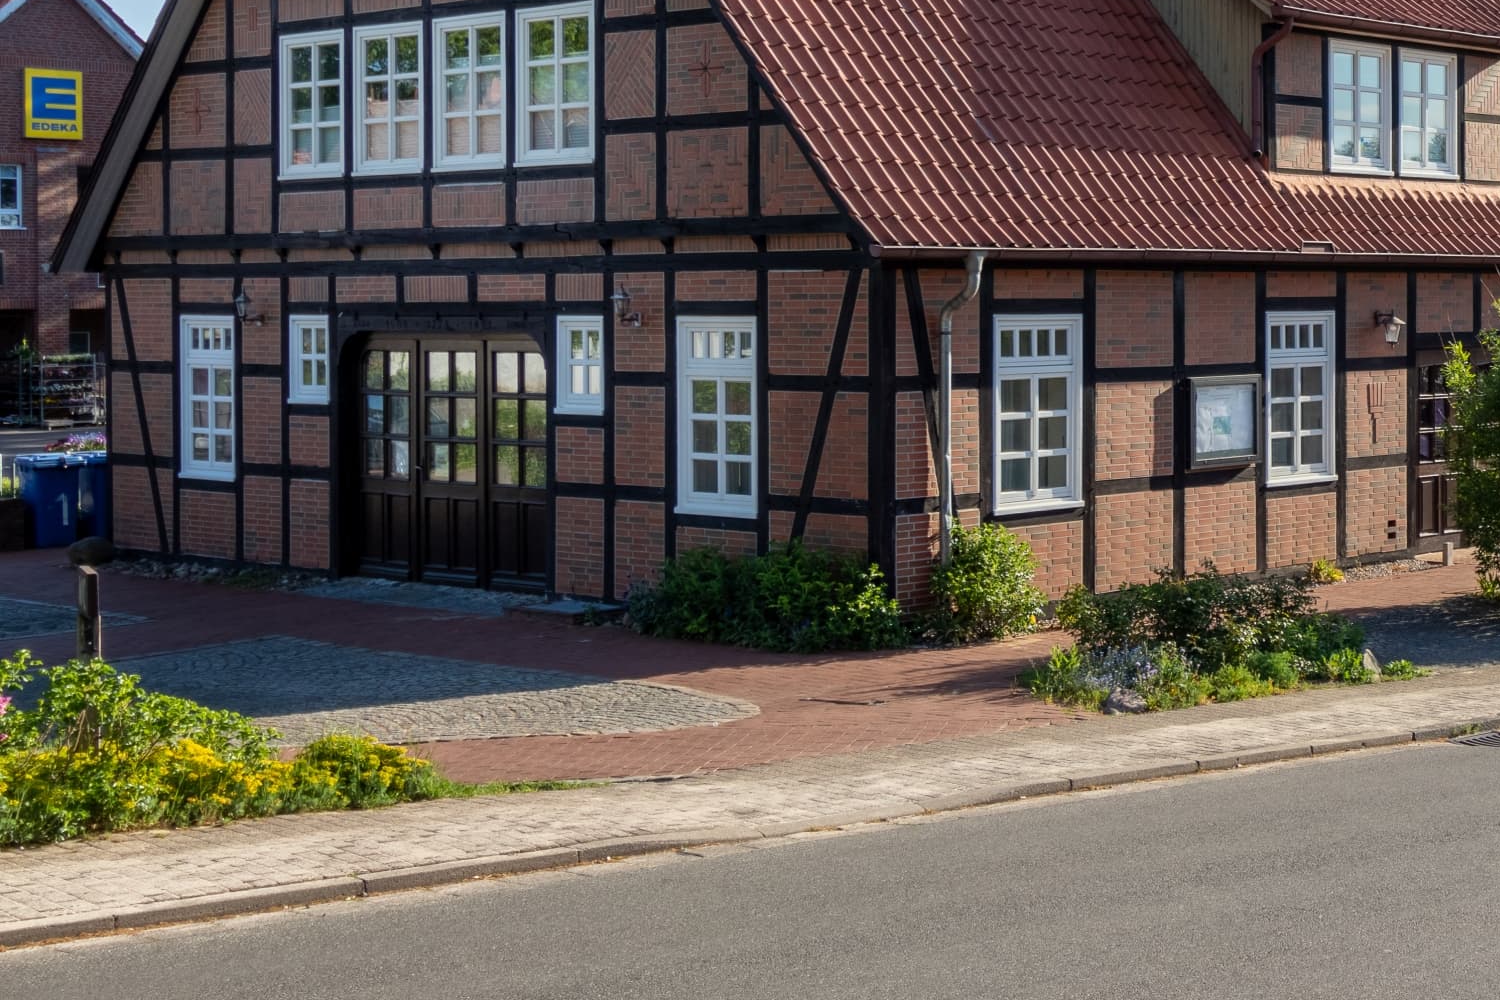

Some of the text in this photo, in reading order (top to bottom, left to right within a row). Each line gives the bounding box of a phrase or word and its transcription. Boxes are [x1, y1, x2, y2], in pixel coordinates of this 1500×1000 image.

[32, 77, 76, 120] E
[32, 122, 78, 132] EDEKA
[56, 493, 69, 526] 1
